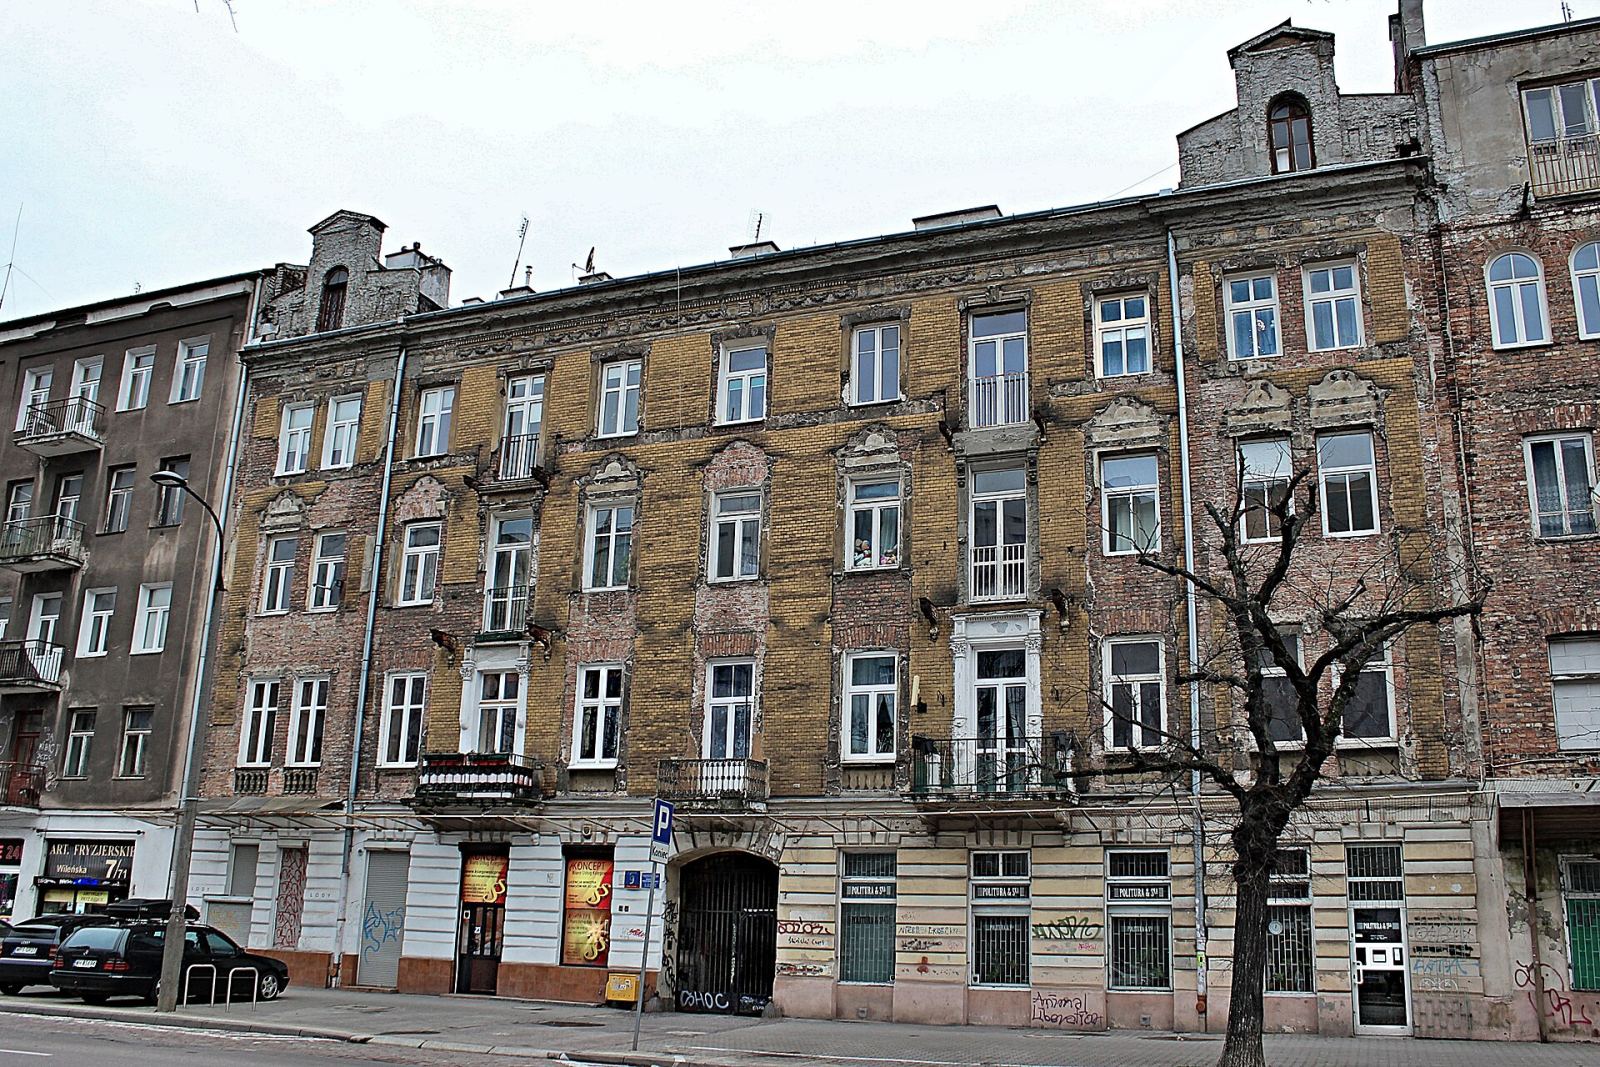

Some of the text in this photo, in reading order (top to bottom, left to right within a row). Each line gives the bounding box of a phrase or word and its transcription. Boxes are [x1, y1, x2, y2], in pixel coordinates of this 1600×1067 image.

[657, 805, 670, 837] P
[49, 843, 70, 855] ART.
[651, 845, 668, 859] Koniec
[56, 864, 88, 874] Wileńska
[569, 861, 606, 871] KONCEPT
[851, 886, 874, 895] POLITURA
[982, 887, 1007, 897] POLITURA
[1119, 888, 1145, 898] POLITURA
[1033, 991, 1087, 1013] Animal
